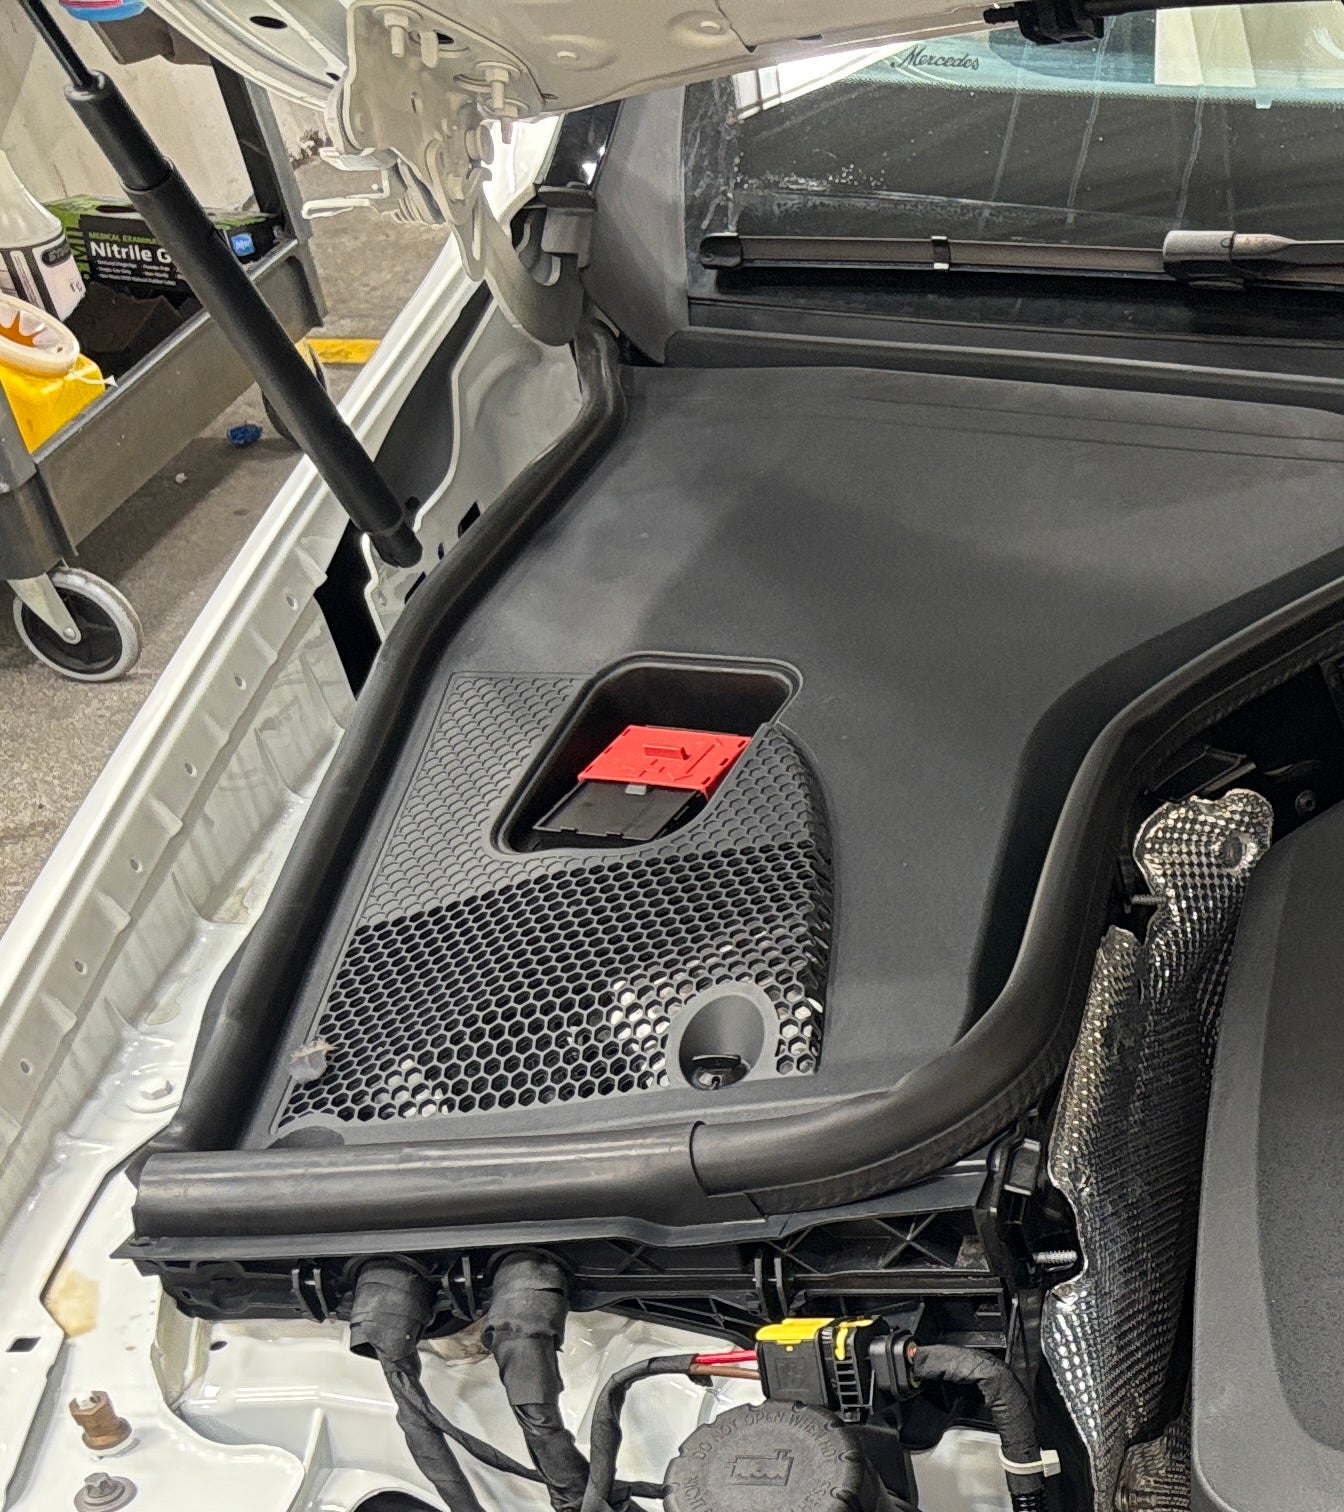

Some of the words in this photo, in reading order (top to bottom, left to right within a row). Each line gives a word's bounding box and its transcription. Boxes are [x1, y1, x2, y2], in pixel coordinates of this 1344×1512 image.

[890, 45, 980, 70] Mercedes
[90, 240, 153, 262] Nitrile
[744, 1410, 785, 1428] OPEN
